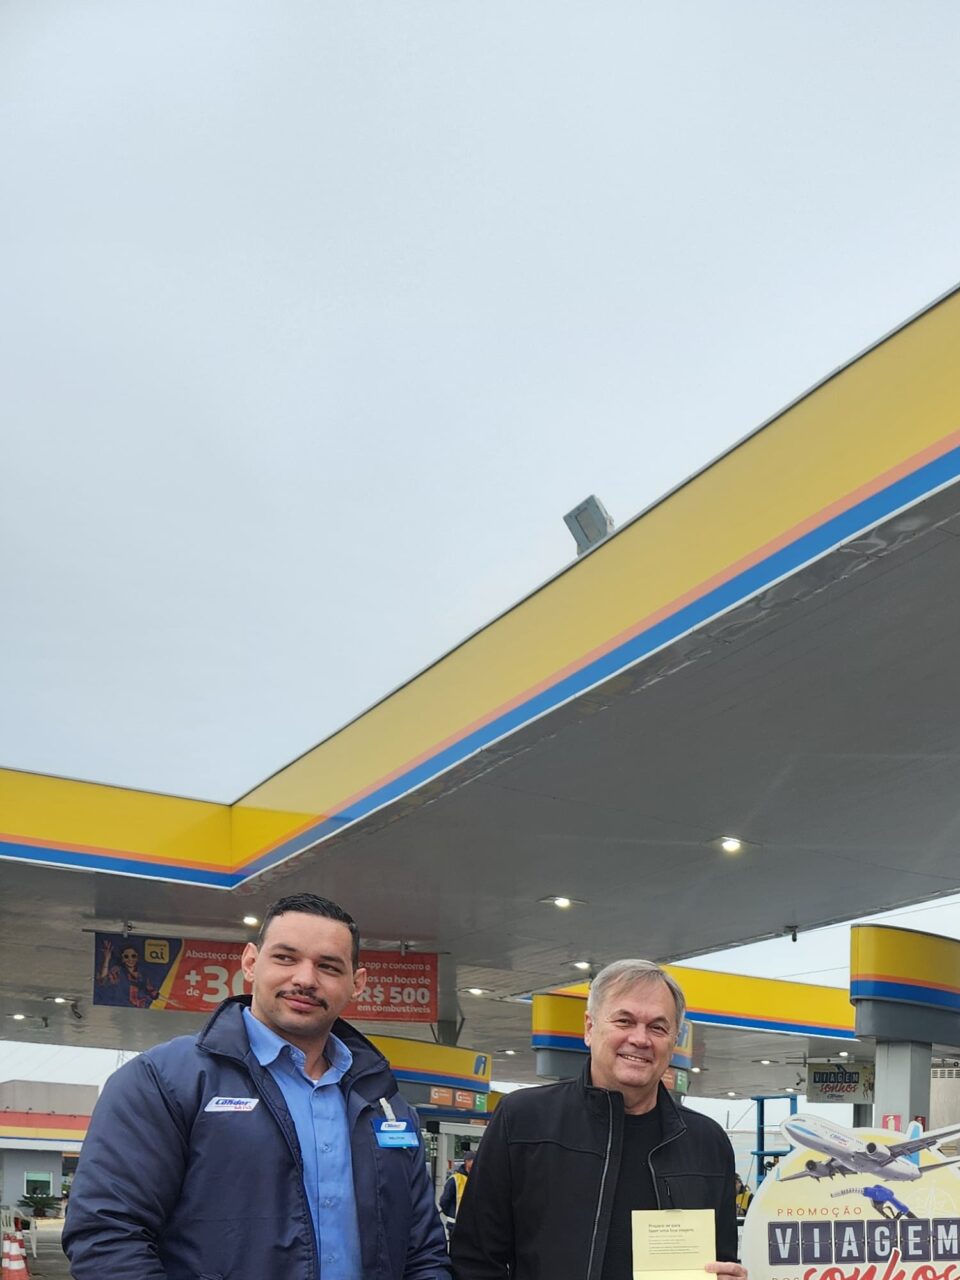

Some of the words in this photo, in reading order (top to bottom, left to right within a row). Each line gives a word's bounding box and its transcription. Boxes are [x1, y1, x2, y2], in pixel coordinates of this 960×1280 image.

[394, 975, 417, 985] hora
[418, 976, 431, 985] de
[186, 987, 200, 997] de
[389, 986, 430, 1004] 500
[815, 1073, 859, 1082] VIAGEM
[777, 1205, 863, 1217] PROMOÇÃO
[775, 1224, 958, 1259] VIAGEM
